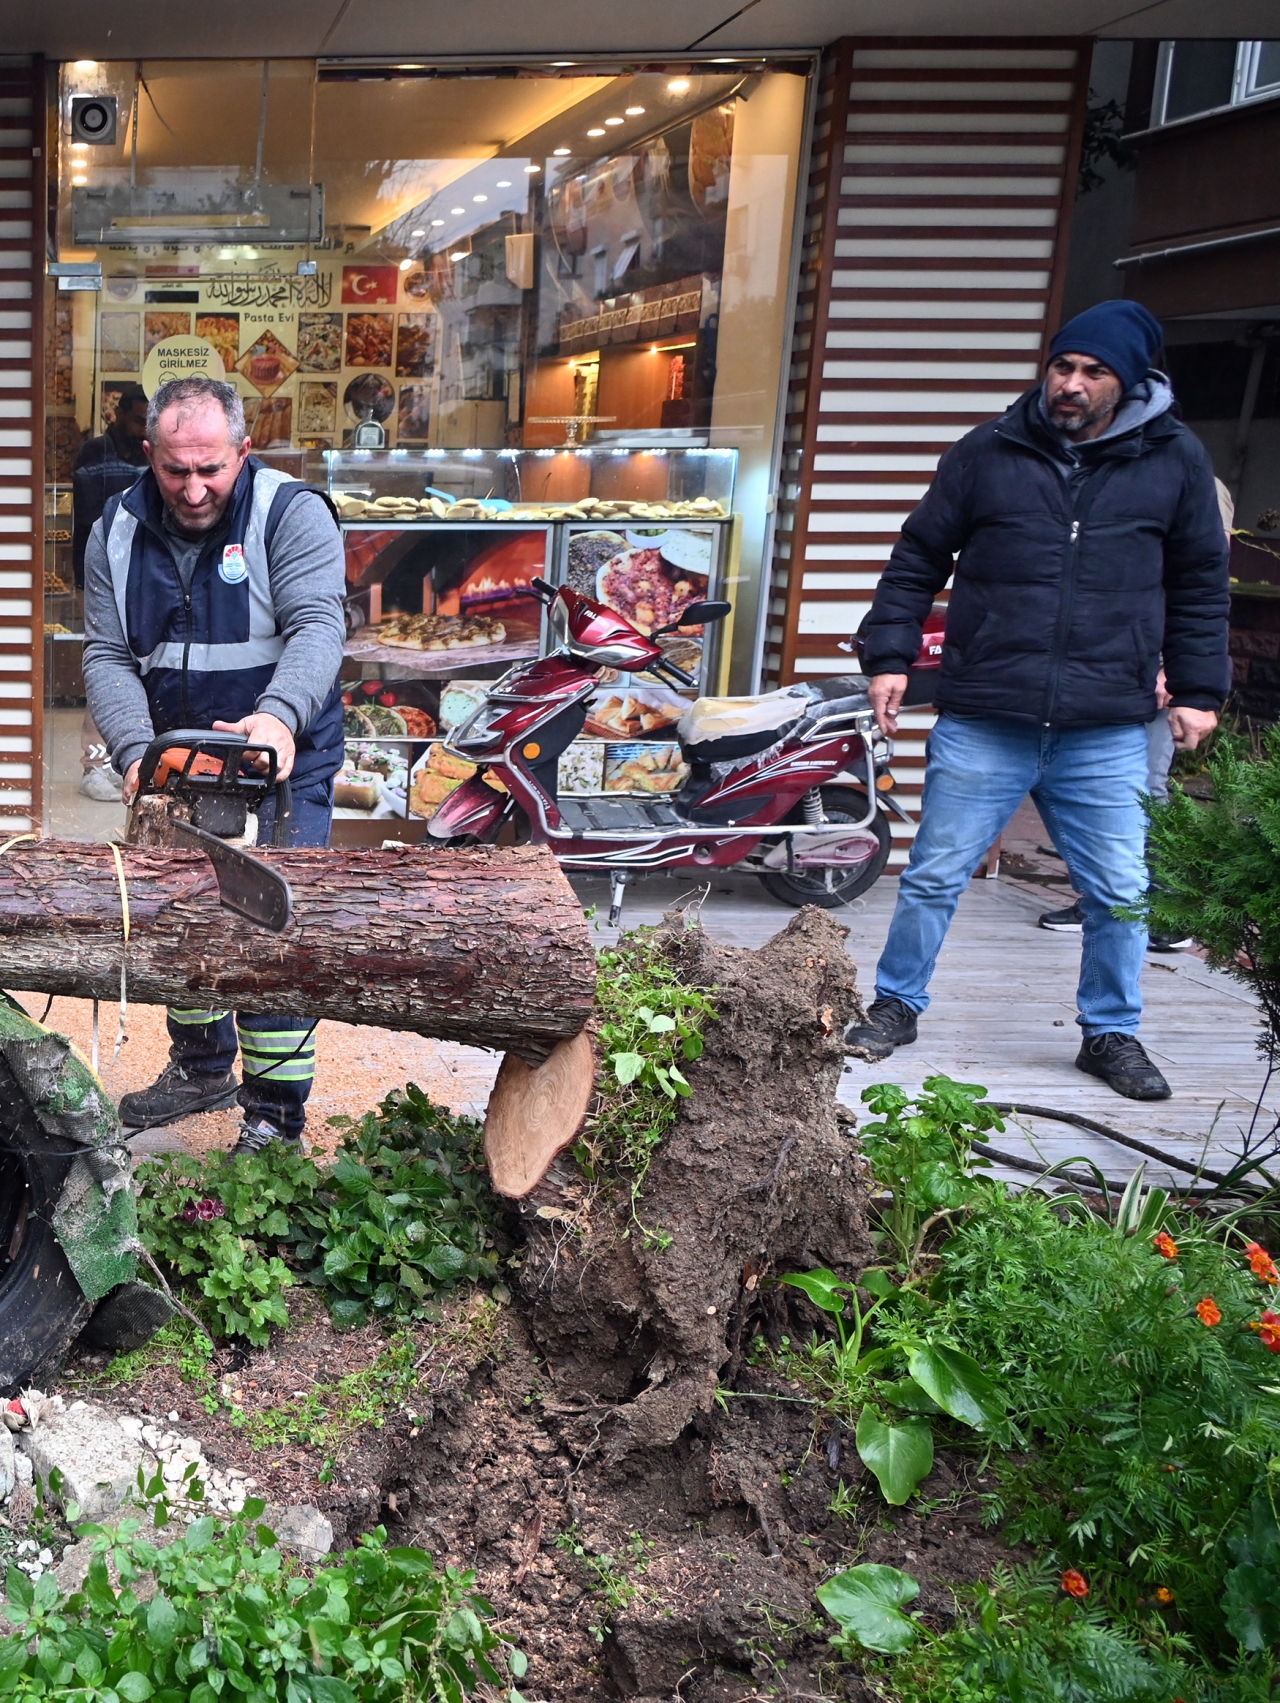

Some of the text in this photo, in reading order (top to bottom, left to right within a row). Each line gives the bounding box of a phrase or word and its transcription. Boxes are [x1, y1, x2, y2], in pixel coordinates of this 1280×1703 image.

[244, 312, 294, 323] Pasta Evi
[157, 346, 210, 357] MASKESİZ
[159, 358, 208, 369] GİRİLMEZ
